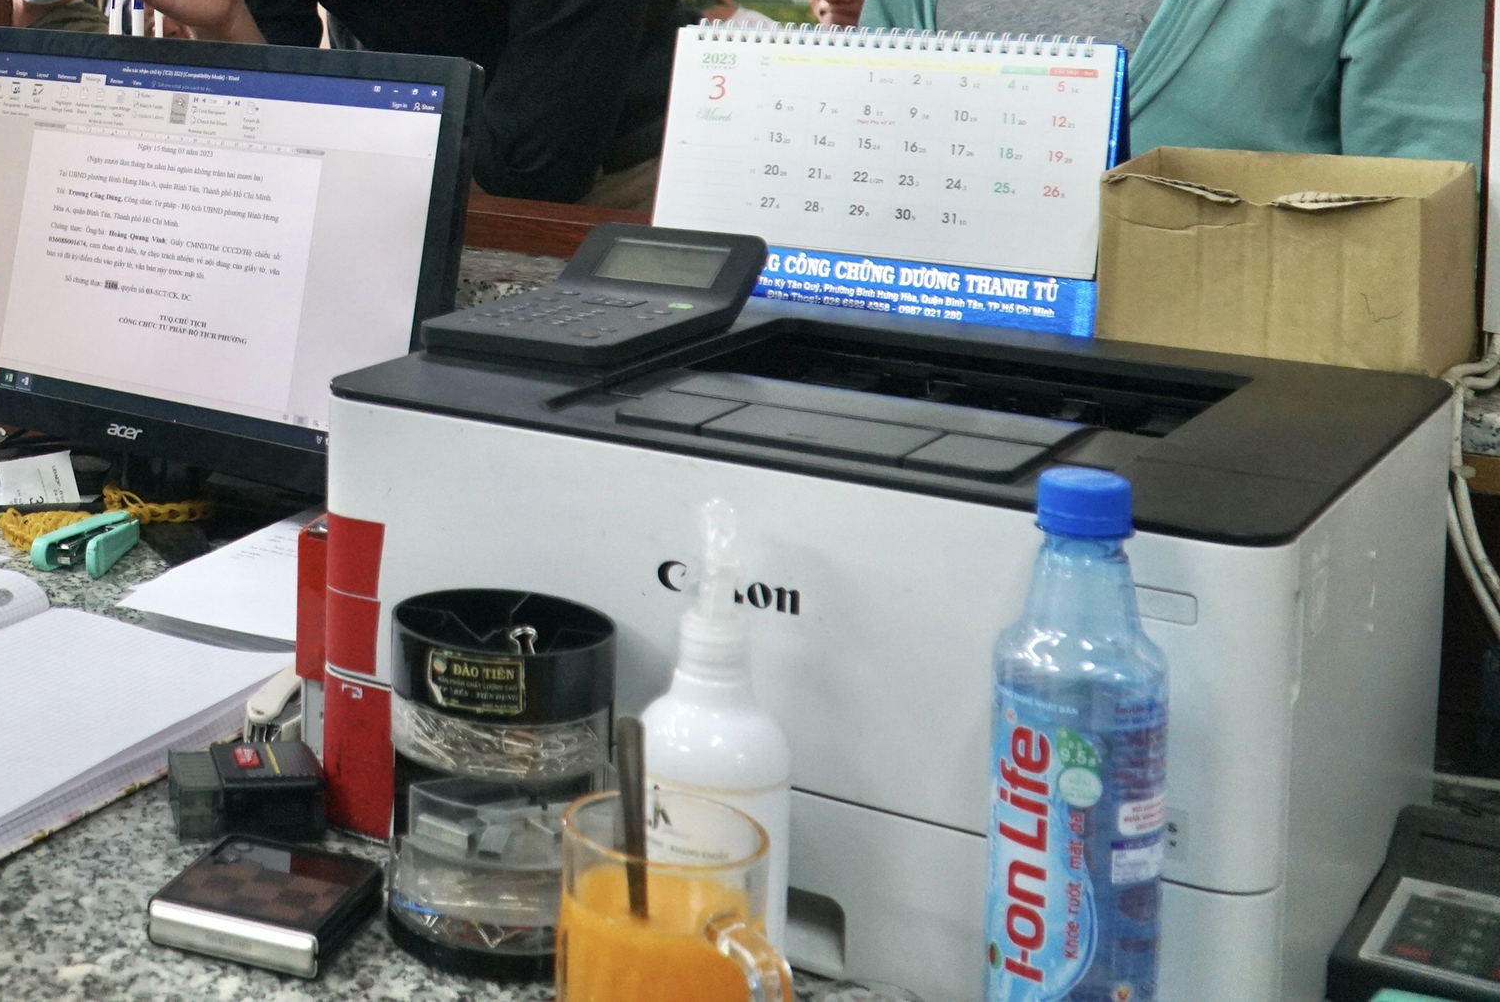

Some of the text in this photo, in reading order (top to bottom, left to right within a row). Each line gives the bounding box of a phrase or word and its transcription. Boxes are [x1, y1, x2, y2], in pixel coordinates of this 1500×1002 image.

[702, 52, 737, 65] 2023
[708, 75, 727, 100] 3
[912, 74, 921, 85] 2
[960, 76, 968, 88] 3
[1008, 79, 1016, 90] 4
[1057, 81, 1066, 93] 5
[421, 103, 435, 112] Share
[696, 106, 733, 122] March
[775, 99, 1067, 128] 6 7 8 9 10 11 12
[769, 131, 1064, 163] 13 14 15 16 17 18 19
[763, 164, 1060, 198] 20 21 22 23 24 25 26
[760, 197, 957, 225] 27 28 29 30 31
[784, 252, 831, 278] CÔNG
[835, 259, 895, 285] CHỨNG
[899, 265, 961, 292] DƯƠNG
[964, 273, 1030, 299] THANH
[107, 423, 144, 442] acer
[657, 560, 800, 615] Con
[999, 726, 1051, 853] Life
